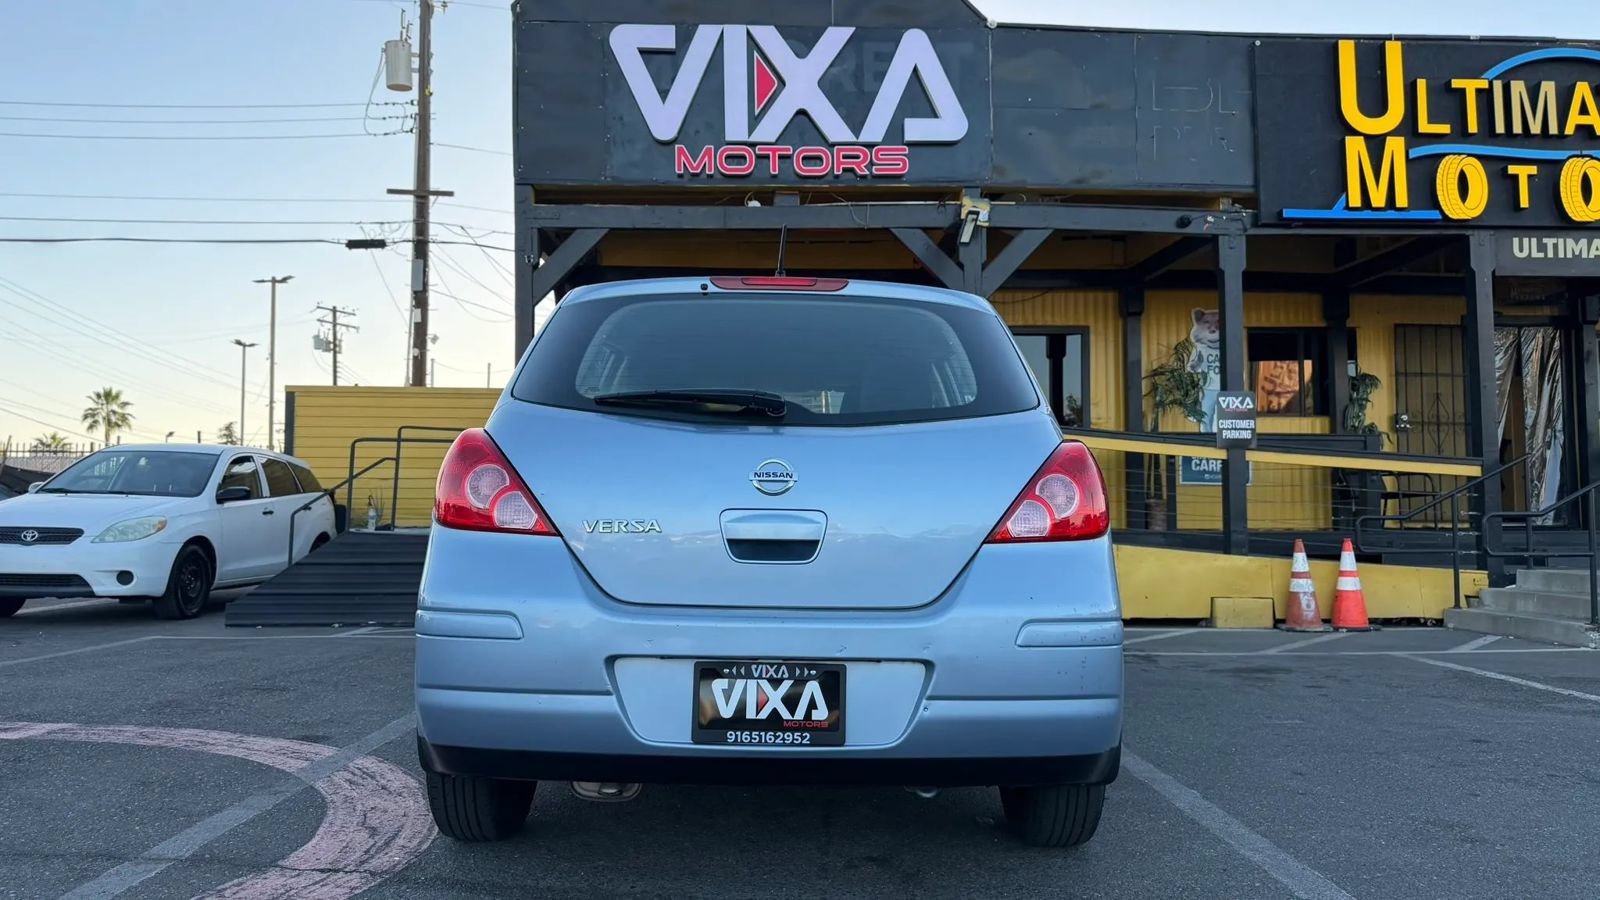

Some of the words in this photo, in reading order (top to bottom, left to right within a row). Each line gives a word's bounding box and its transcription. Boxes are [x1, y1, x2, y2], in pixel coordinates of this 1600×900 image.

[609, 24, 968, 143] VIXA
[674, 144, 909, 176] MOTORS
[1512, 237, 1600, 258] ULTIMA
[1219, 396, 1253, 408] VIXA
[1218, 419, 1255, 429] CUSTOMER
[1222, 430, 1252, 440] PARKING
[753, 471, 794, 479] NISSAN
[582, 519, 662, 533] VERSA
[751, 664, 789, 678] VIXA
[711, 678, 829, 720] VIXA
[783, 720, 829, 728] MOTORS
[726, 731, 811, 744] 9165162952
